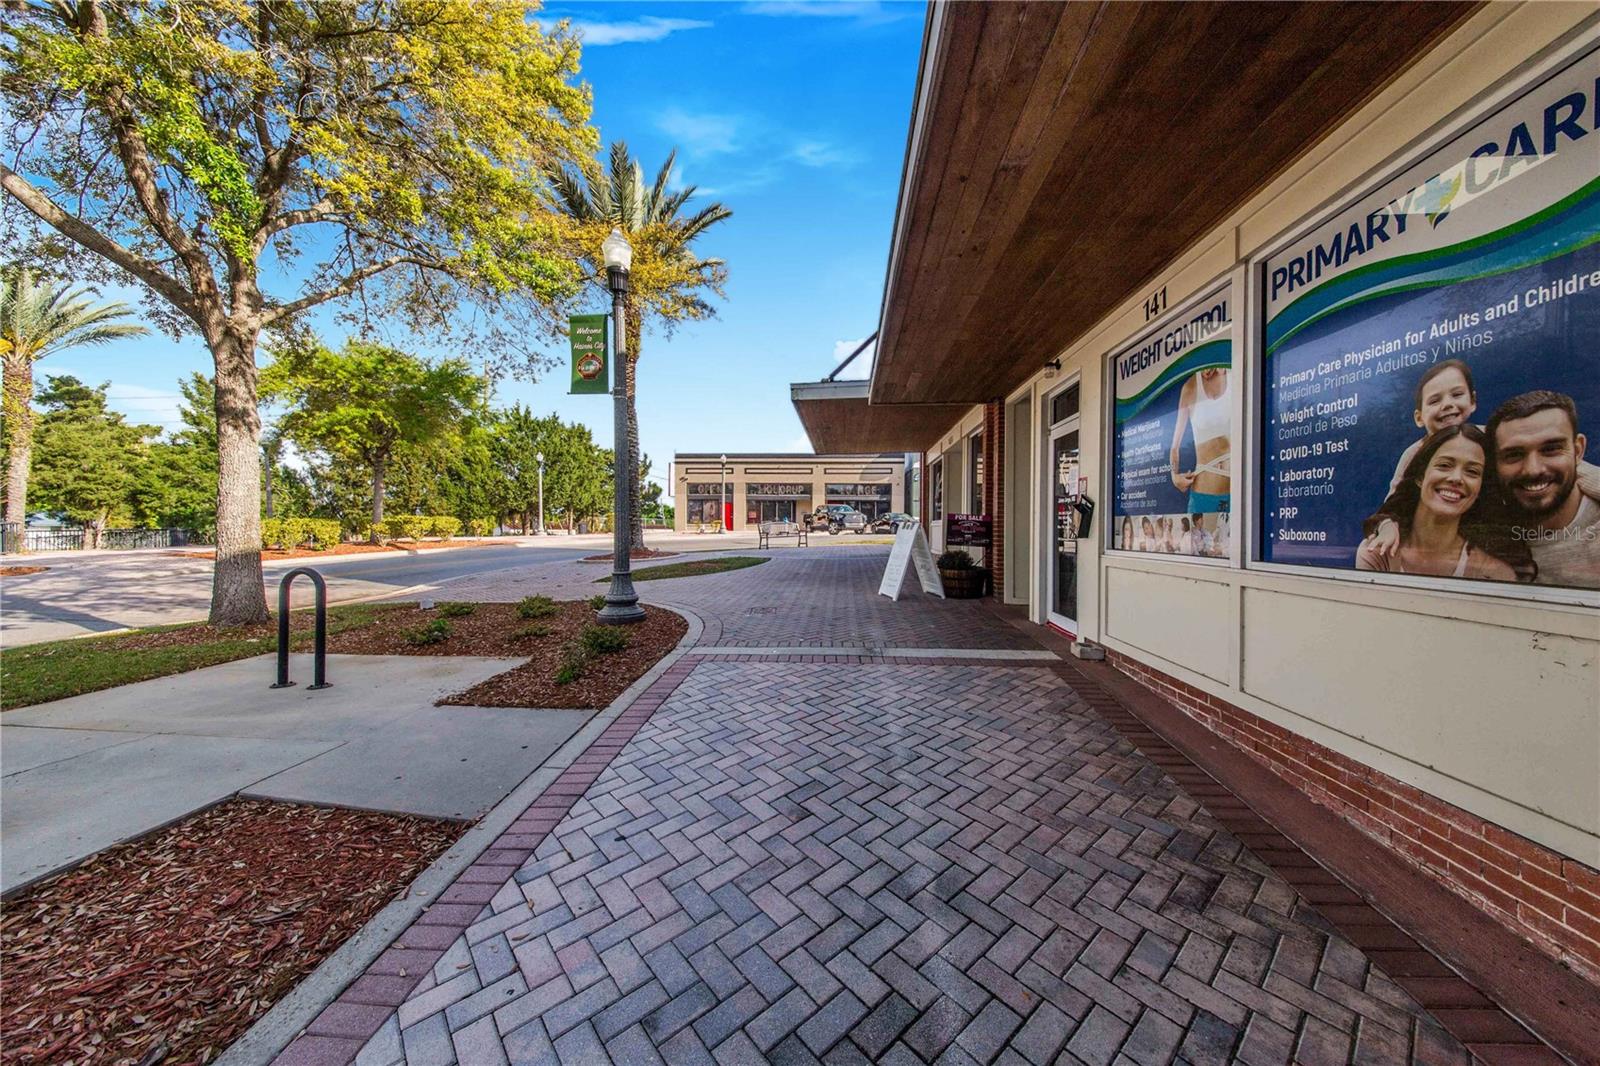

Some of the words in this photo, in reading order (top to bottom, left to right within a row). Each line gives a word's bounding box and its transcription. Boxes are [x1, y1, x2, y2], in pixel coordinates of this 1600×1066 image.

[1271, 190, 1416, 301] PRIMARY
[1465, 76, 1600, 195] CAR
[1143, 285, 1168, 321] 141
[576, 327, 602, 335] Welcome
[1120, 338, 1163, 380] WEIGHT
[1164, 300, 1232, 357] CONTROL
[1279, 365, 1317, 389] Primary
[1317, 357, 1342, 376] Care
[1344, 338, 1401, 368] Physician
[1405, 329, 1426, 348] for
[1429, 310, 1480, 340] Adults
[1484, 294, 1519, 321] and
[1525, 270, 1600, 308] Childre
[1278, 380, 1321, 403] Medicina
[1323, 366, 1372, 389] Primaria
[1375, 348, 1427, 375] Adultos
[1431, 347, 1440, 364] y
[1444, 328, 1494, 355] Niños
[1280, 404, 1314, 424] Weight
[1316, 393, 1358, 416] Control
[1278, 423, 1312, 440] Control
[1315, 419, 1328, 432] de
[1331, 414, 1358, 430] Peso
[1279, 442, 1323, 462] COVID-19
[1325, 438, 1349, 454] Test
[1279, 467, 1335, 483] Laboratory
[1120, 492, 1128, 500] Car
[1278, 482, 1334, 498] Laboratorio
[1279, 507, 1298, 519] PRP
[1279, 528, 1327, 542] Suboxone
